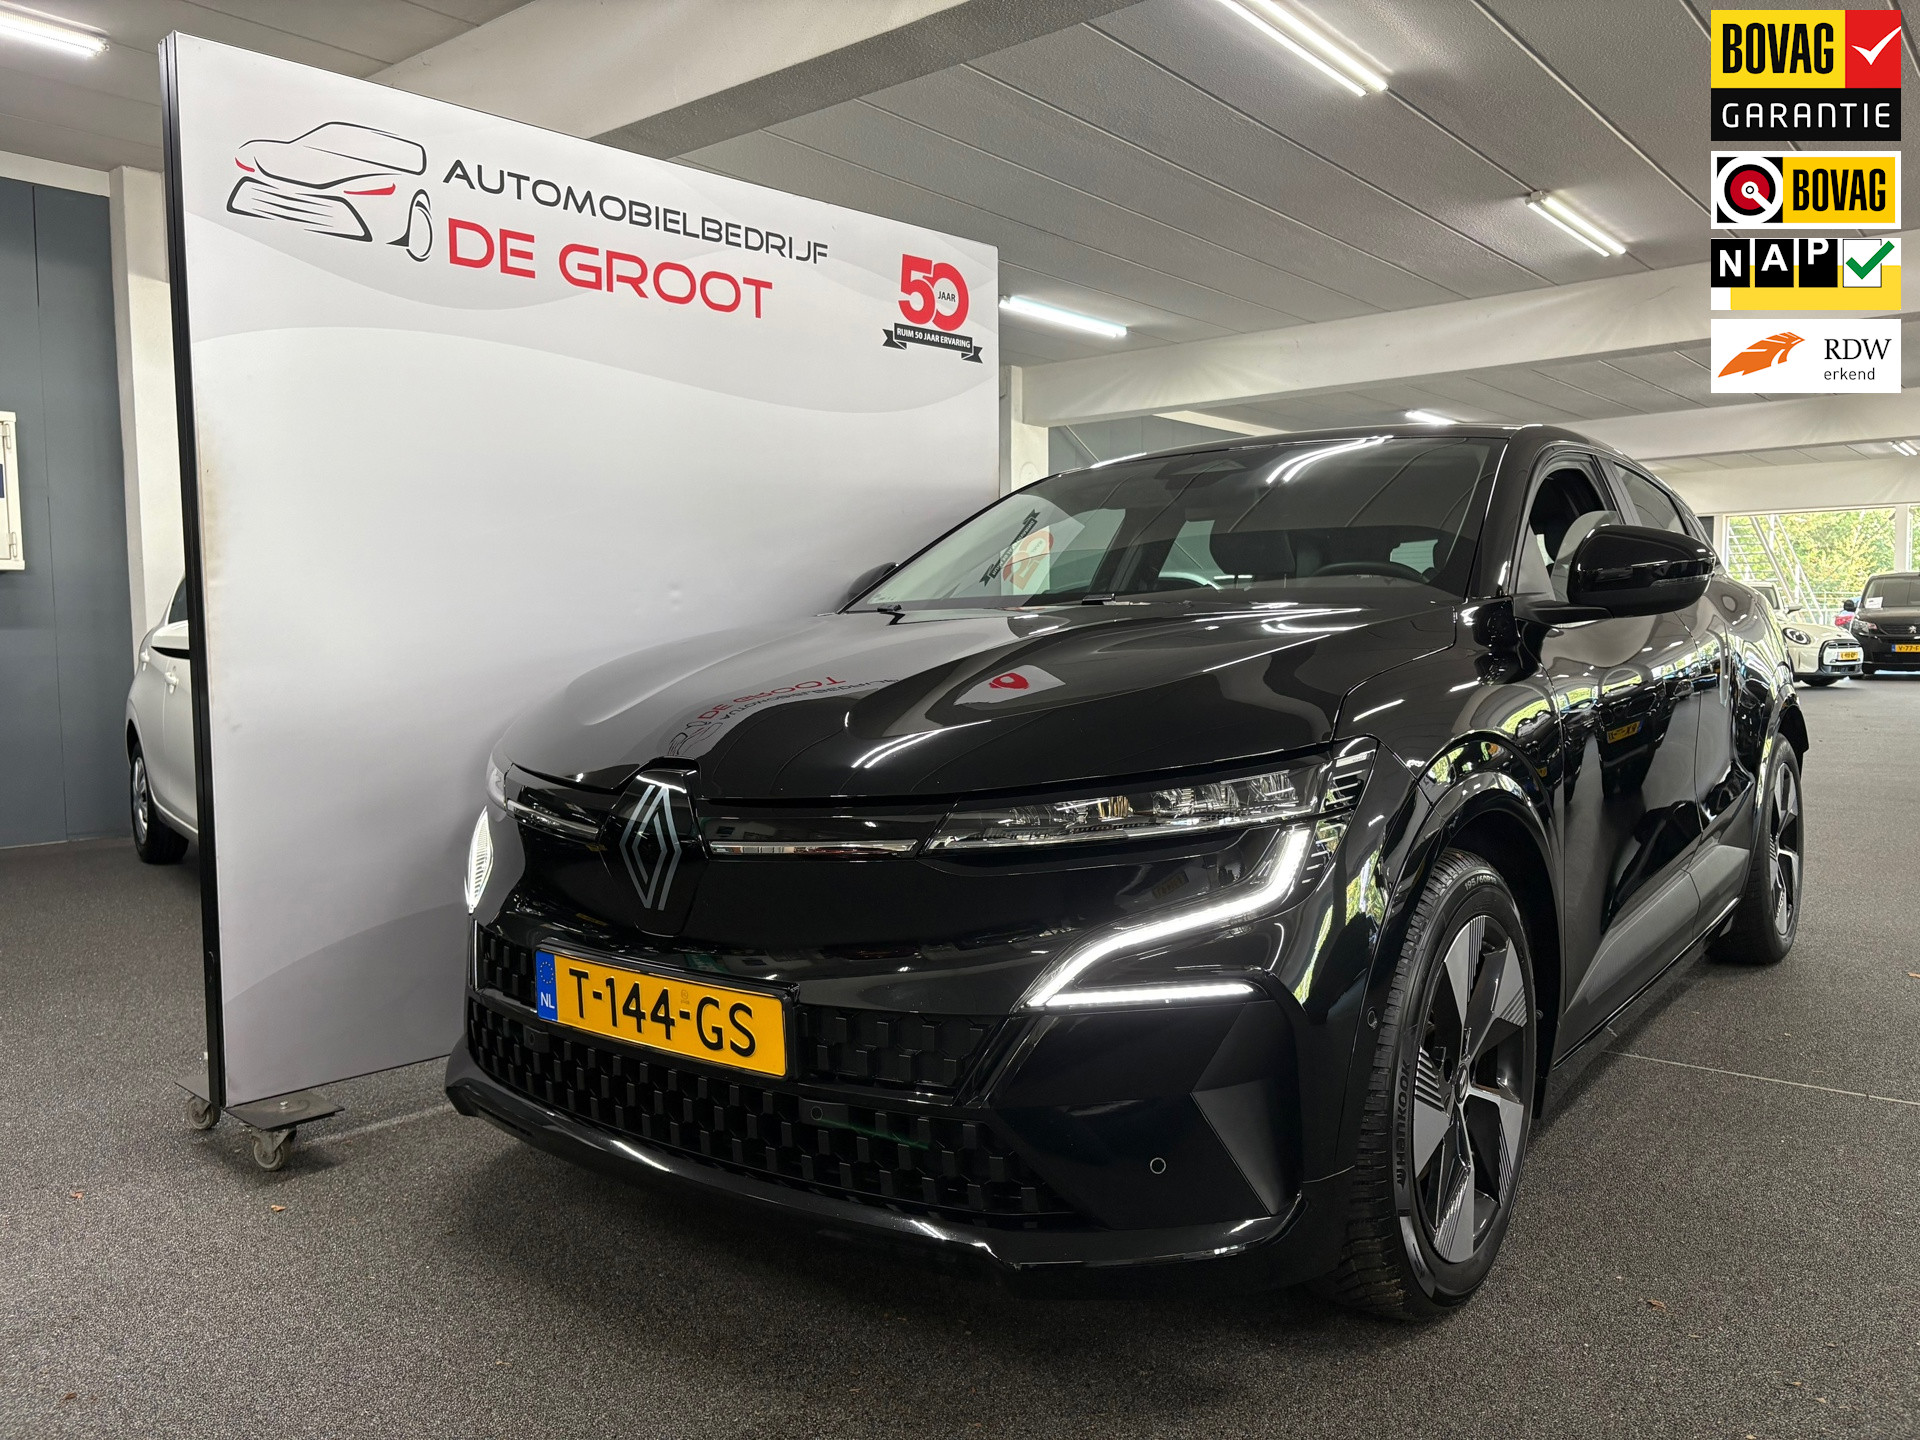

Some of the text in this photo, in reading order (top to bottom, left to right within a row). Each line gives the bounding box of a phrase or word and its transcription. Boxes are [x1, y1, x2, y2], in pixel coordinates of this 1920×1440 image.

[443, 159, 829, 265] AUTOMOBIELBEDRIJF
[447, 217, 773, 319] DE GROOT
[898, 254, 969, 331] 50
[937, 291, 956, 302] JAAR
[896, 328, 971, 348] RUIM 50 JAAR ERVARING
[540, 991, 555, 1010] NL
[568, 967, 756, 1057] T-144-GS
